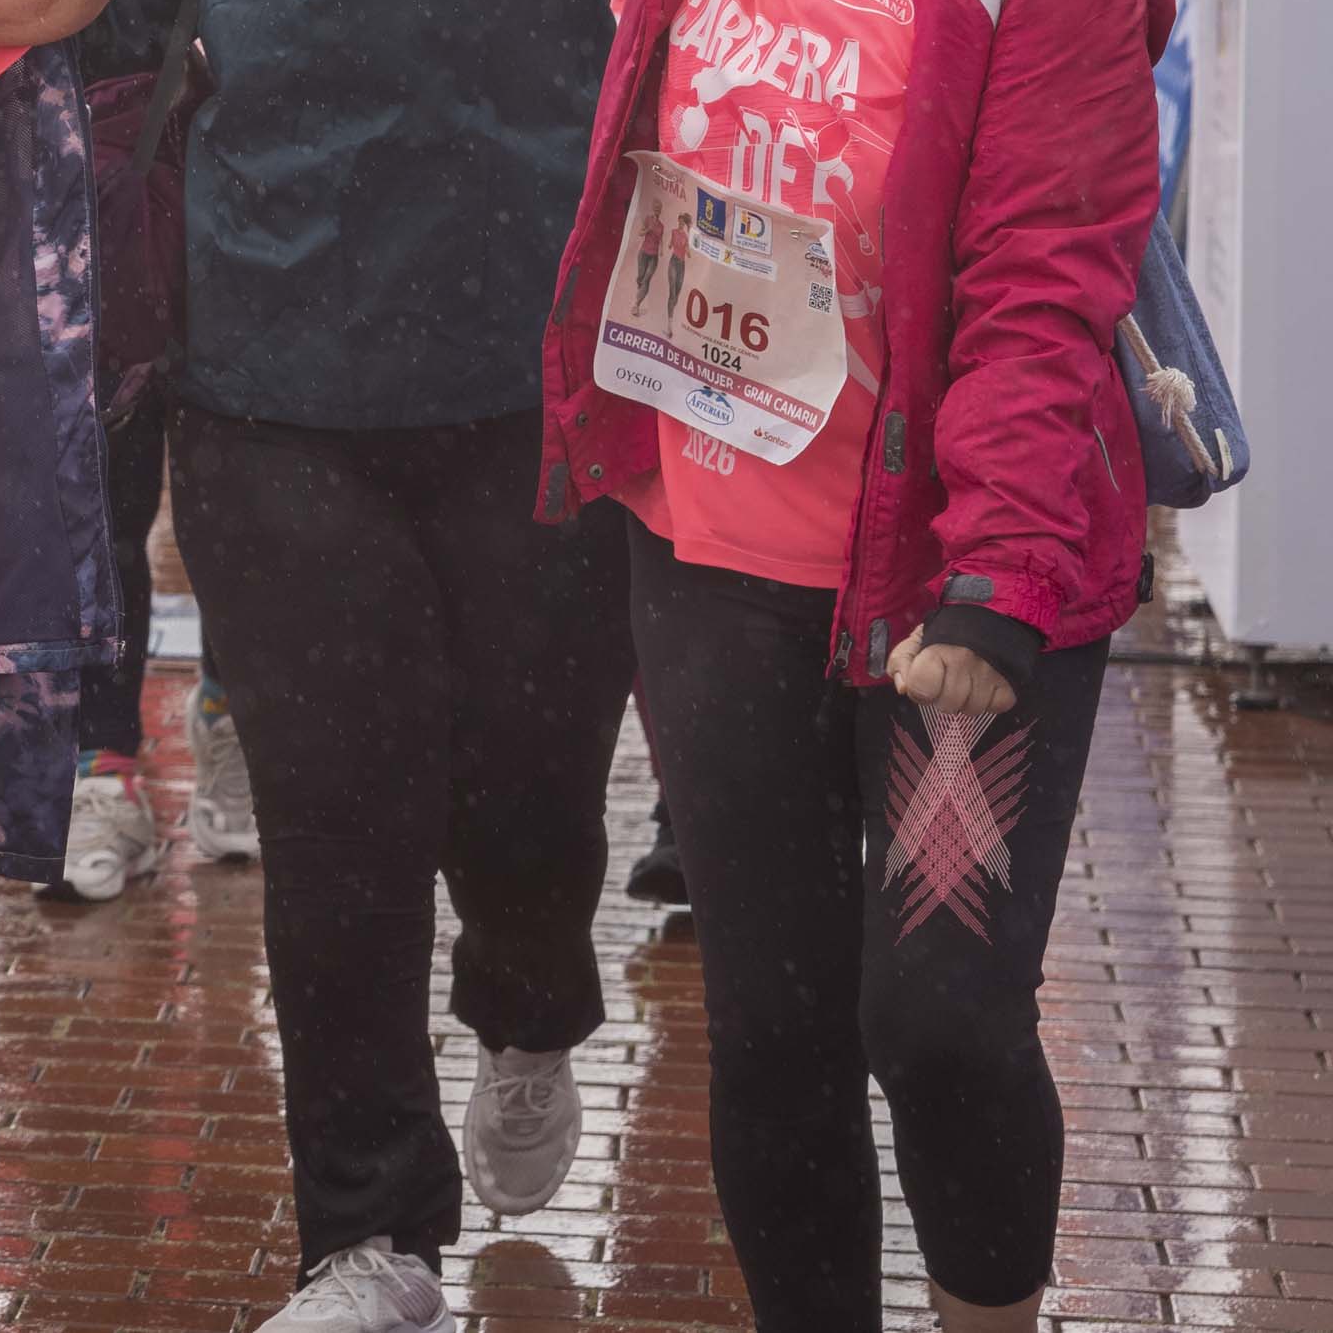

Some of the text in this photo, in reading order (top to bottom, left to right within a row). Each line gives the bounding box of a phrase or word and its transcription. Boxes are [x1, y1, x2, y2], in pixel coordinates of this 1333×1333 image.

[686, 288, 770, 352] 016
[701, 343, 742, 372] 1024
[609, 328, 664, 358] CARRERA
[666, 349, 680, 366] DE
[682, 355, 695, 373] LA
[696, 361, 734, 390] MUJER
[744, 384, 771, 407] GRAN
[773, 396, 818, 428] CANARIA
[616, 367, 663, 393] OYSHO
[689, 395, 731, 423] ASTURIANA
